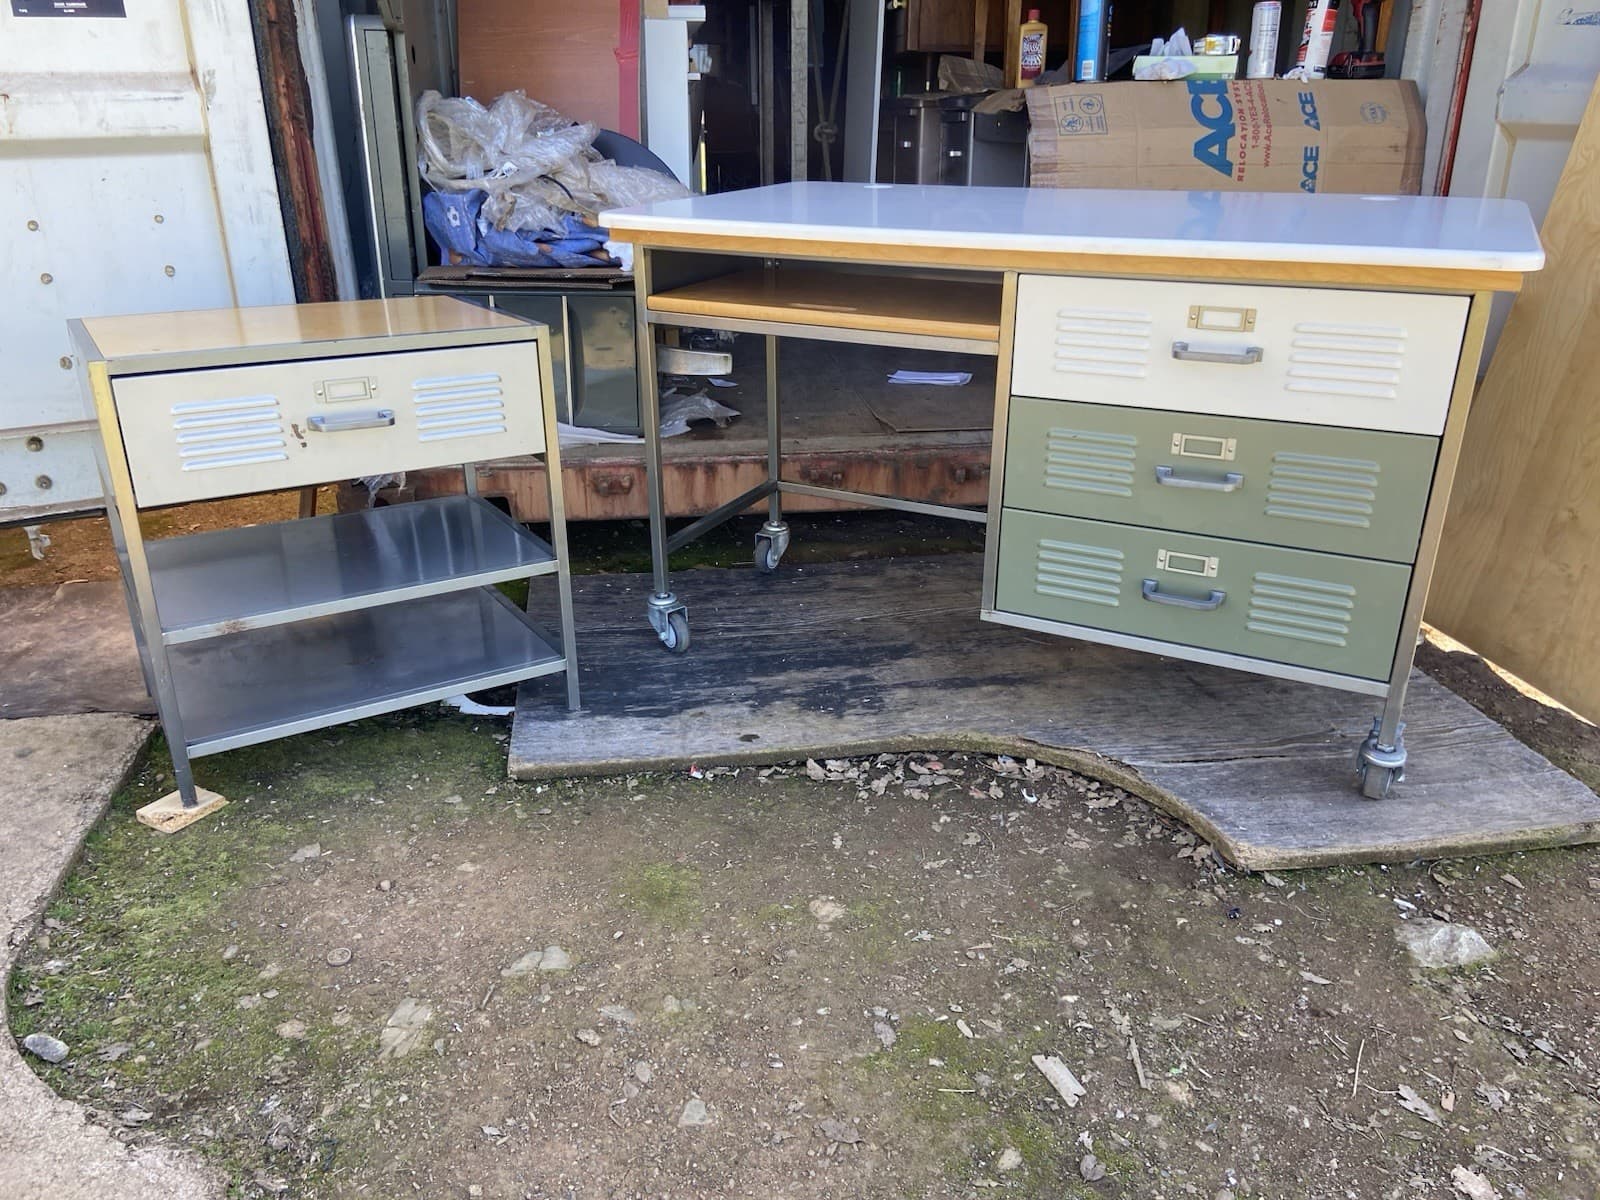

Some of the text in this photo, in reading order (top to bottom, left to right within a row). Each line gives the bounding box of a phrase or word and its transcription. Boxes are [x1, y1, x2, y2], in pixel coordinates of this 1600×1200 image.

[1257, 80, 1273, 168] www.AceRelocation.
[1298, 91, 1321, 132] ACE
[1237, 108, 1249, 182] RELOCATION
[1300, 146, 1320, 194] ACE
